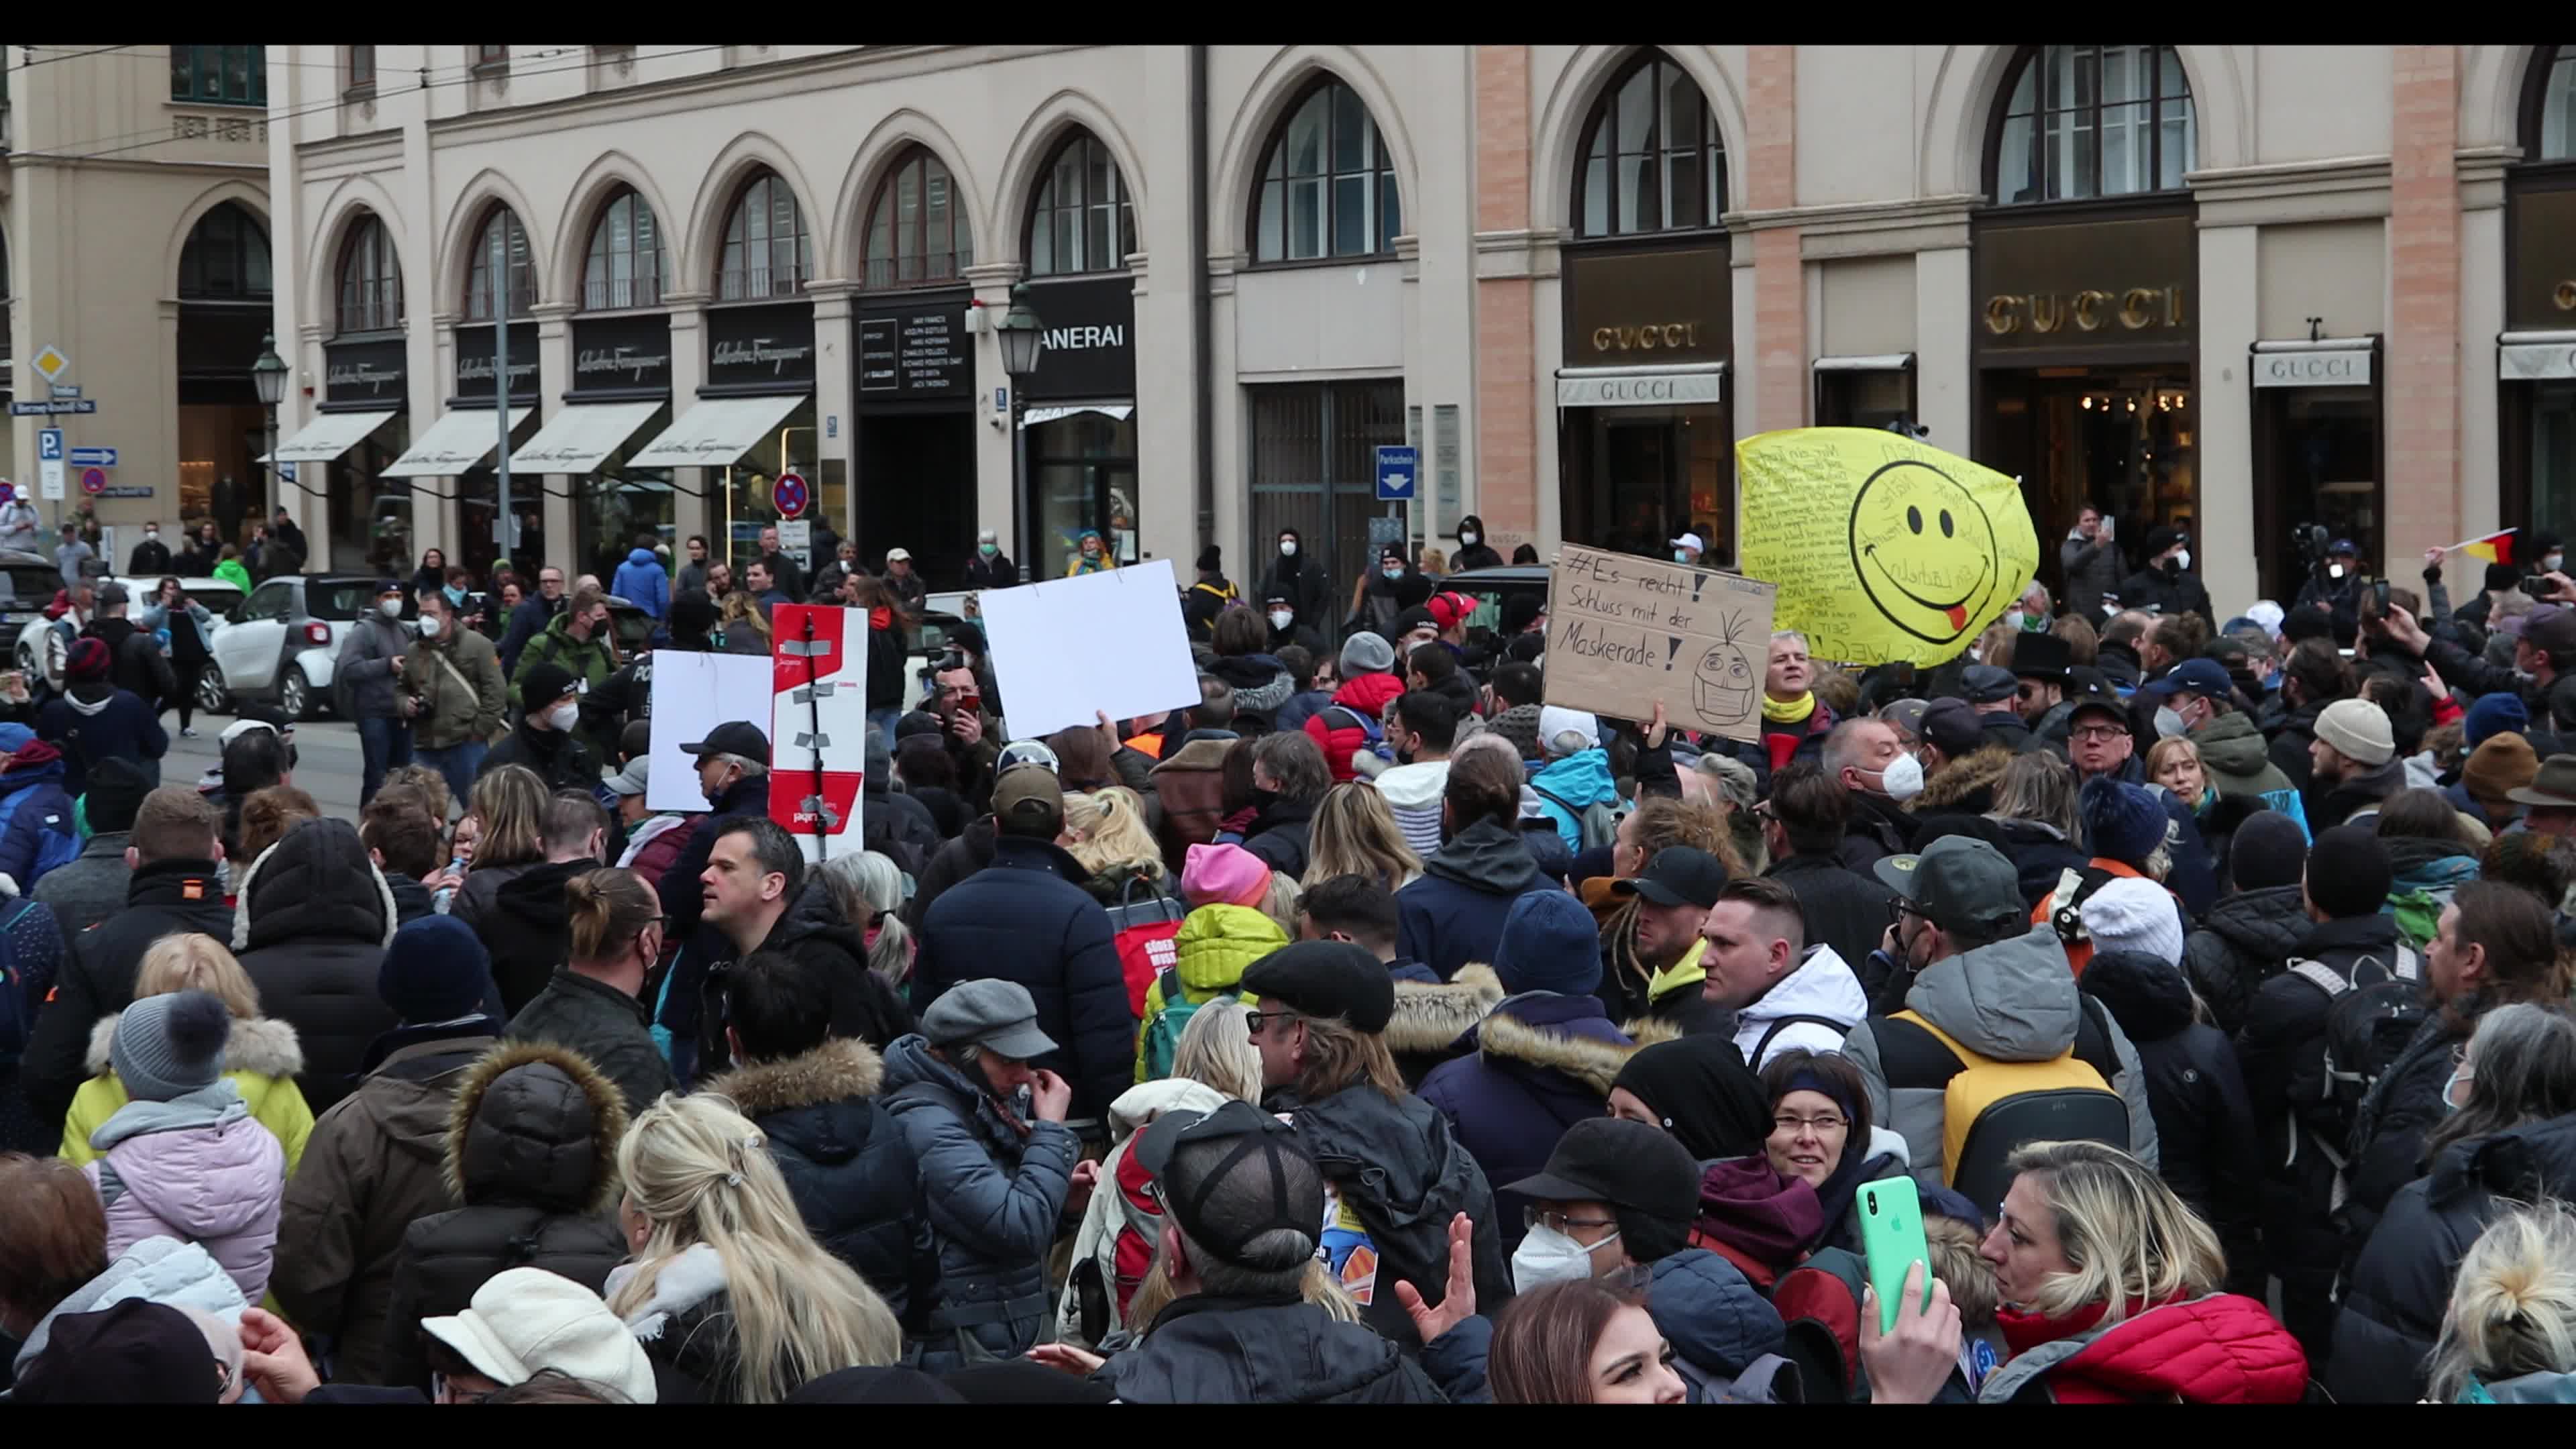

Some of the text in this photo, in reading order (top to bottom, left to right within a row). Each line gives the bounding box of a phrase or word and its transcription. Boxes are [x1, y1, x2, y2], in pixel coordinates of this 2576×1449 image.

[1984, 287, 2184, 334] GUCCI
[1041, 325, 1123, 350] ANERAI
[1593, 323, 1698, 351] GUCCI
[2271, 359, 2351, 377] GUCCI
[1601, 380, 1674, 400] GUCCI
[42, 433, 56, 456] P
[1567, 552, 1620, 583] #Es
[1632, 602, 1657, 622] mit
[1669, 606, 1692, 629] der
